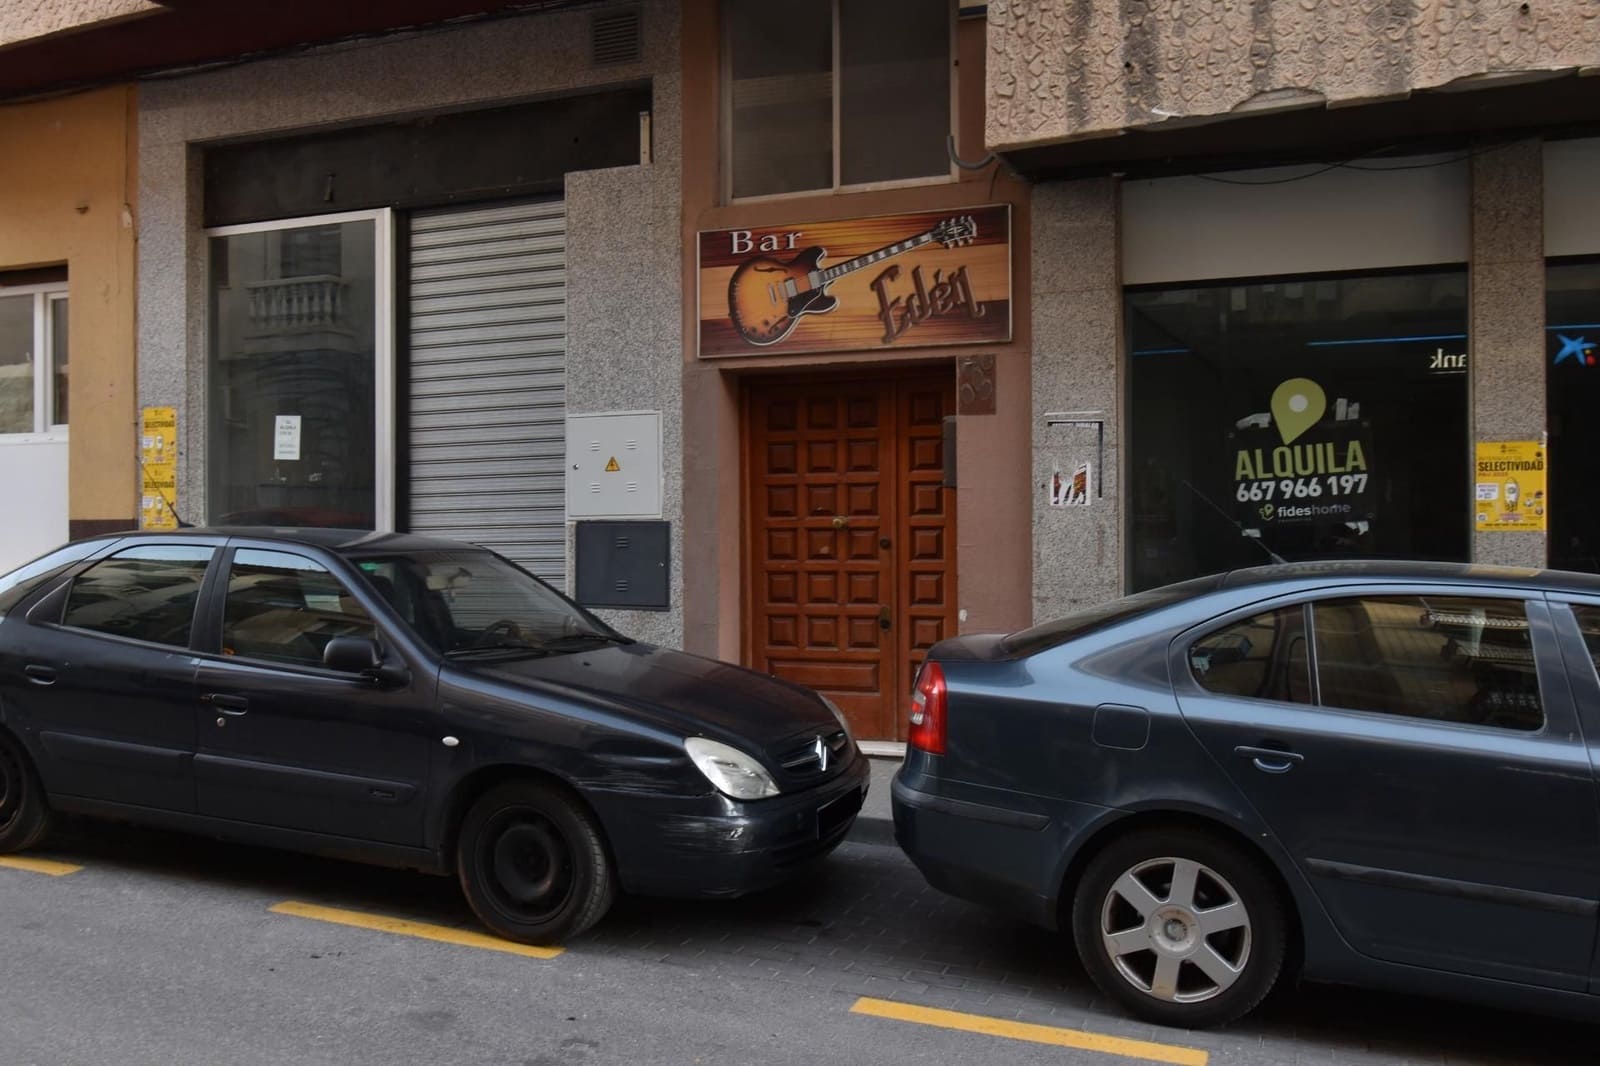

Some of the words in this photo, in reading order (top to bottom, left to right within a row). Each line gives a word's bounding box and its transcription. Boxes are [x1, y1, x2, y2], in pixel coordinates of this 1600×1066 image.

[729, 229, 803, 255] Bar
[869, 263, 986, 344] Edén
[1235, 440, 1367, 480] ALQUILA
[1478, 461, 1544, 471] SELECTIVIDAD
[1236, 481, 1276, 502] 667
[1279, 477, 1322, 499] 966
[1327, 473, 1368, 496] 197
[1277, 503, 1351, 518] fideshome
